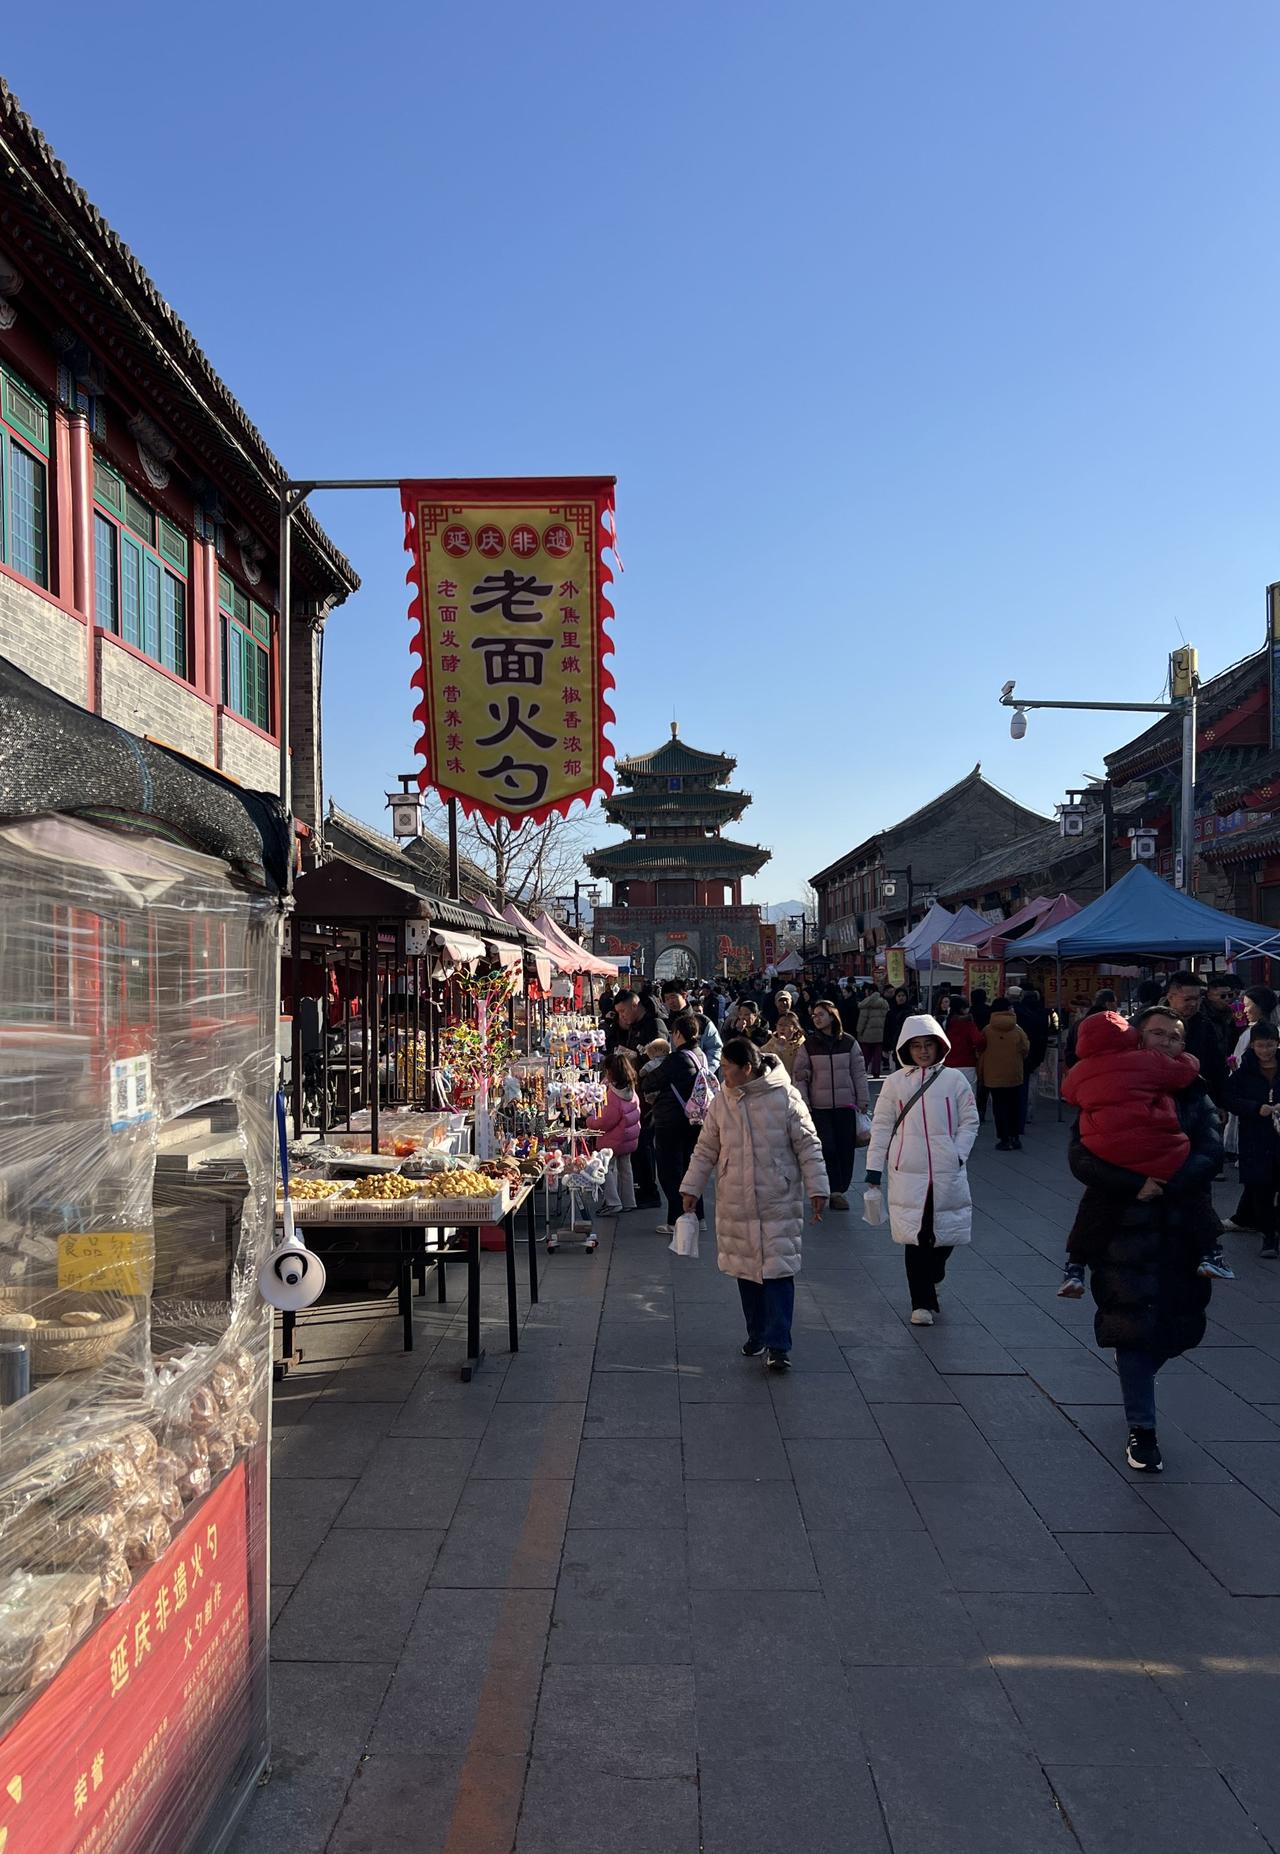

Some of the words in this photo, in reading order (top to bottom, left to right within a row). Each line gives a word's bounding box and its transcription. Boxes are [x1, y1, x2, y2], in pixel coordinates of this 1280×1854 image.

[447, 530, 571, 553] 延庆非遗
[437, 578, 461, 673] 老面发酵
[558, 580, 582, 674] 外焦里嫩
[442, 685, 466, 774] 营养美味
[470, 568, 558, 807] 老面火勺
[561, 686, 584, 776] 椒香浓郁
[109, 1522, 218, 1698] 延庆非遗火勺
[73, 1747, 105, 1818] 荣誉
